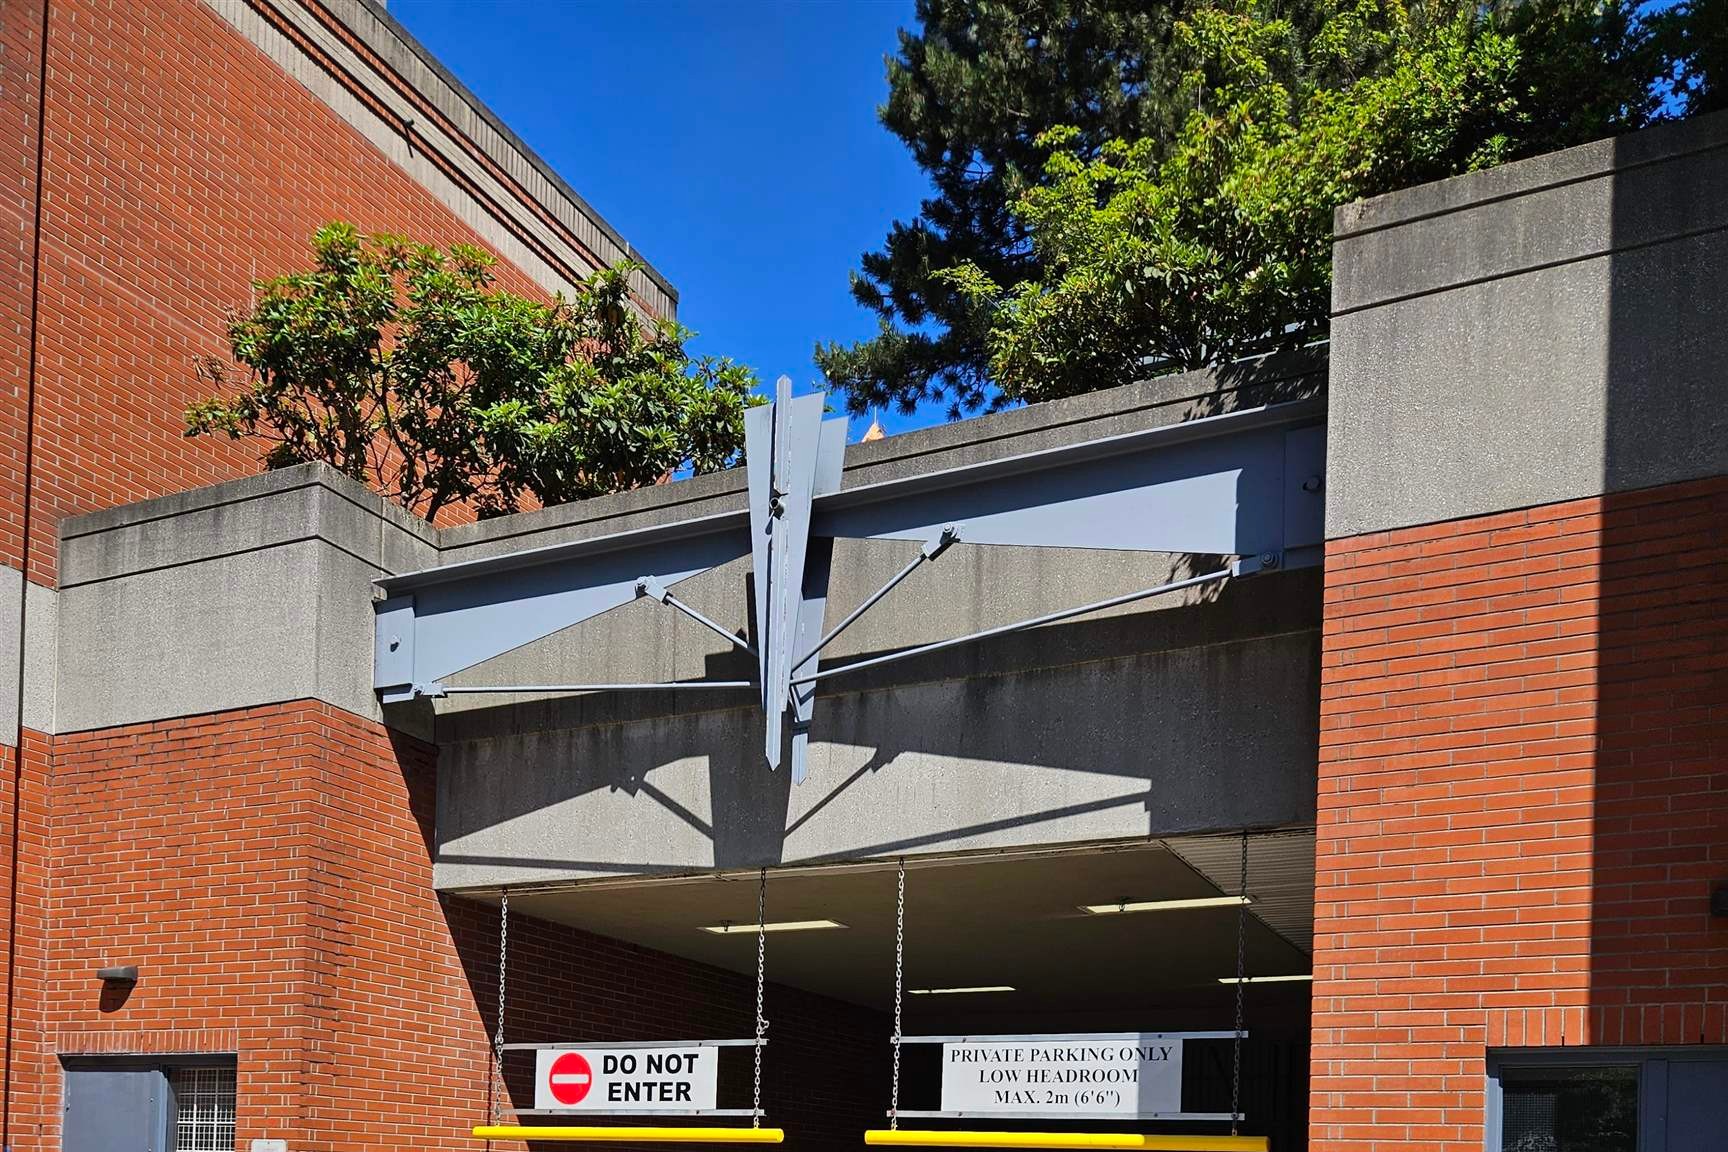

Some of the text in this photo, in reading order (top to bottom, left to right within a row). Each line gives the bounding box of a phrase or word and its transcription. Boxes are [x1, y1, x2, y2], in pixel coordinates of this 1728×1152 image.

[951, 1046, 1173, 1063] PRIVATE PARKING ONLY
[602, 1053, 699, 1075] DO NOT
[979, 1068, 1138, 1083] LOW HEADROOM
[608, 1082, 692, 1102] ENTER
[994, 1090, 1040, 1104] MAX.
[1046, 1090, 1069, 1104] 2m
